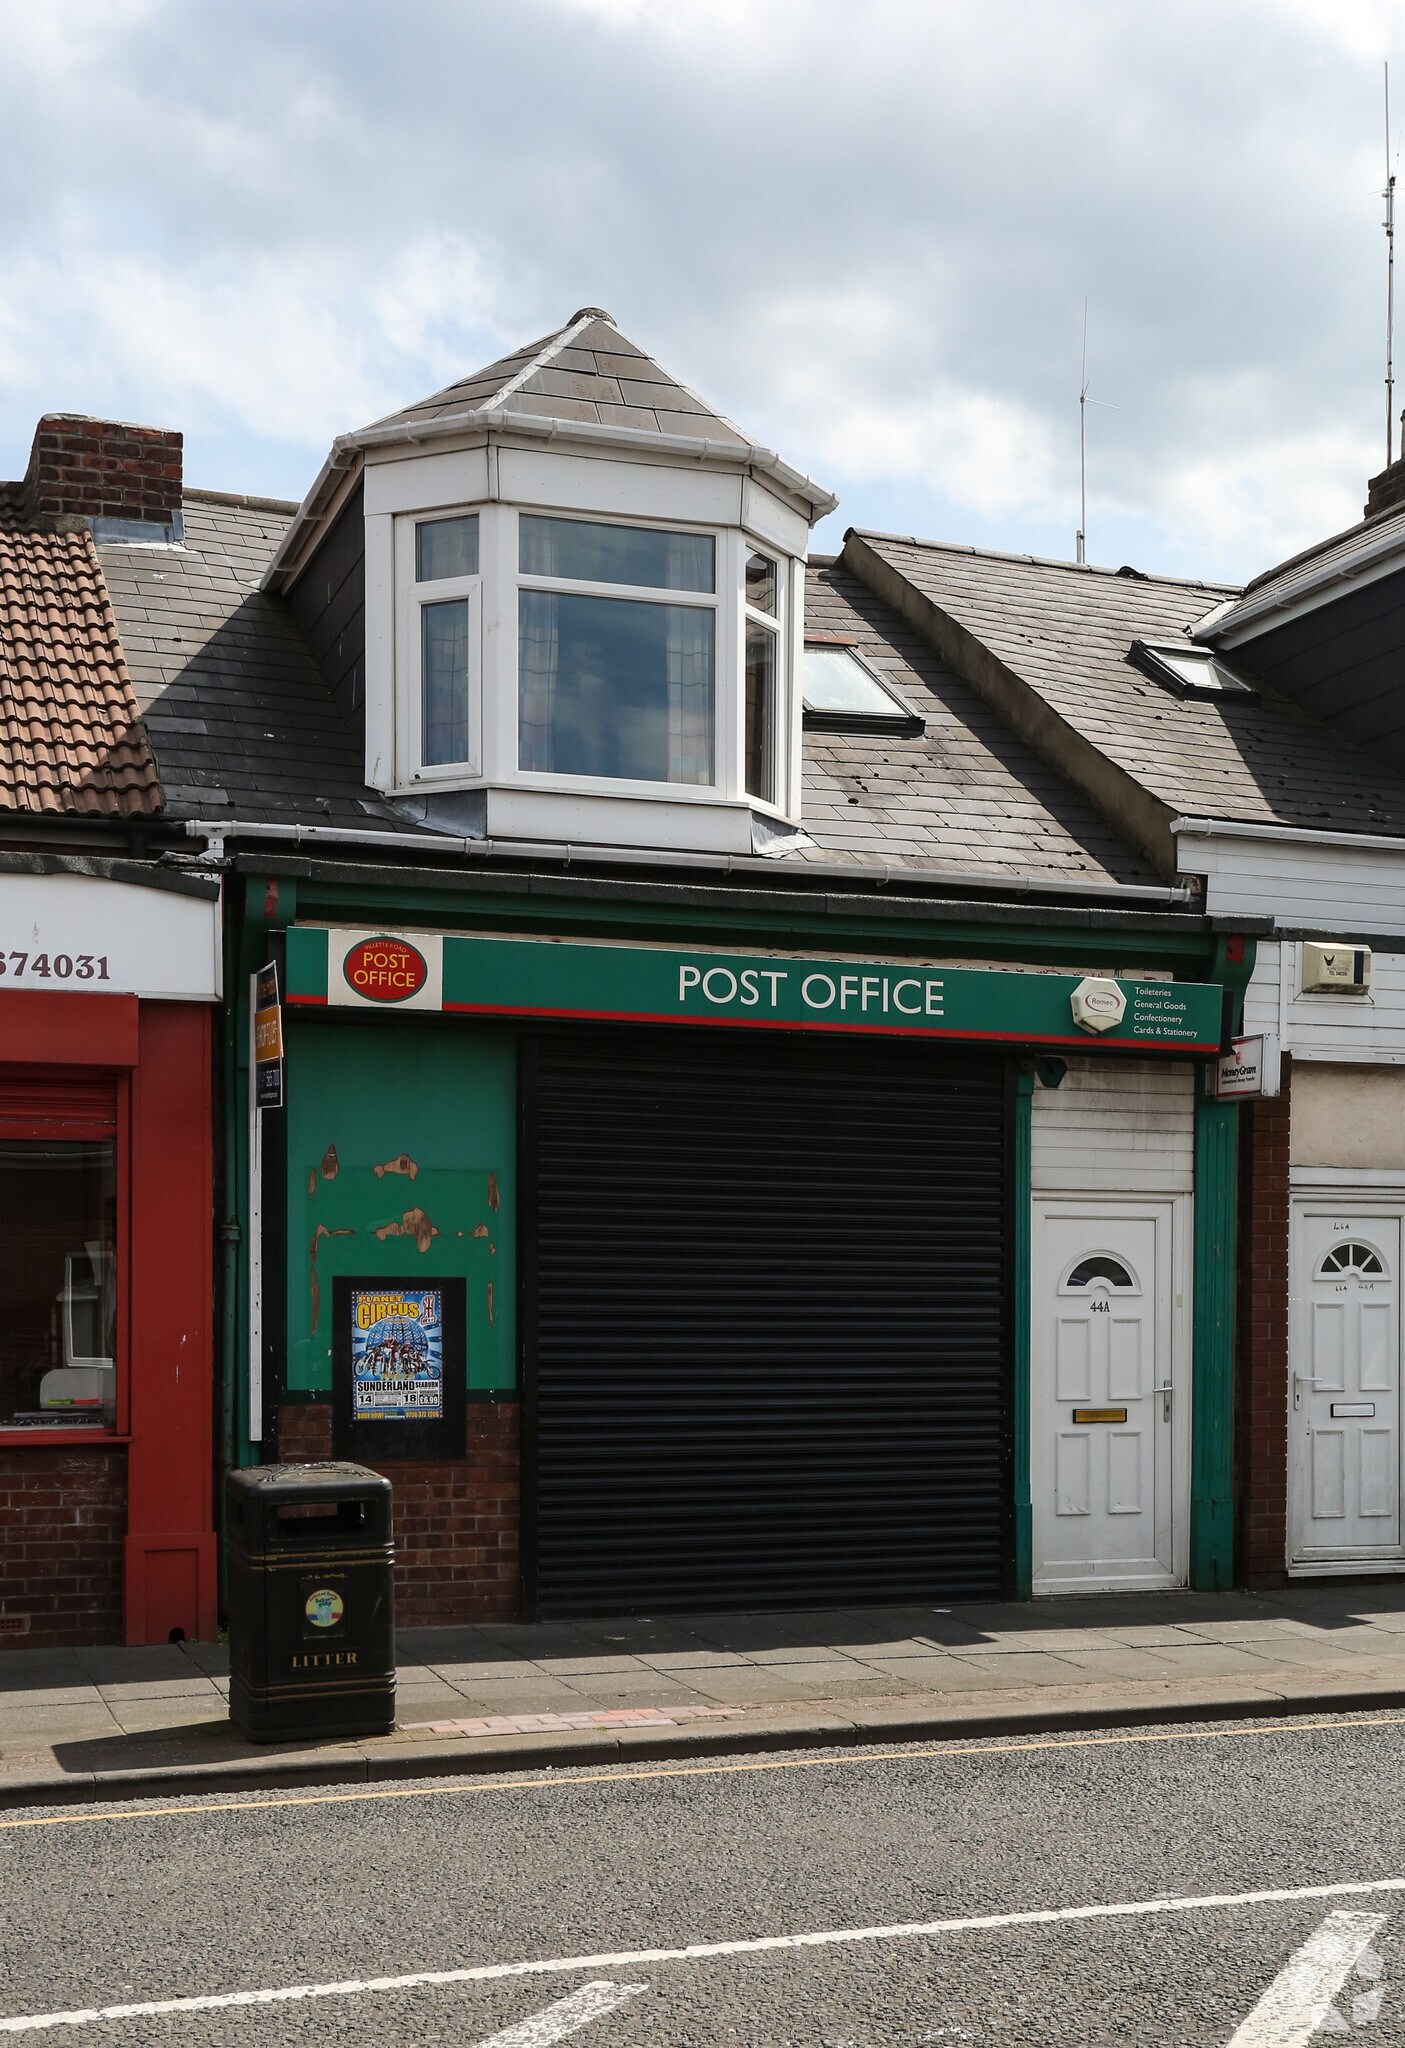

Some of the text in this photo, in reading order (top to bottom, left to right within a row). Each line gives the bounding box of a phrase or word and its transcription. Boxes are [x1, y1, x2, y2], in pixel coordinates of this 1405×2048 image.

[364, 942, 407, 953] VILLETTE ROAD
[363, 952, 410, 969] POST
[353, 969, 416, 987] OFFICE
[679, 965, 945, 1016] POST OFFICE
[1134, 986, 1172, 997] Toileteries
[1134, 1000, 1187, 1011] General Goods
[1133, 1013, 1183, 1024] Confectionery
[1133, 1025, 1198, 1038] Cards & Stationery
[357, 1295, 404, 1303] PLANET
[1090, 1301, 1110, 1312] 44A
[357, 1302, 419, 1330] CIRCUS
[357, 1380, 415, 1391] SUNDERLAND
[359, 1395, 373, 1403] 14
[403, 1394, 417, 1402] 18
[419, 1396, 438, 1405] £6.99
[292, 1652, 358, 1669] LITTER
